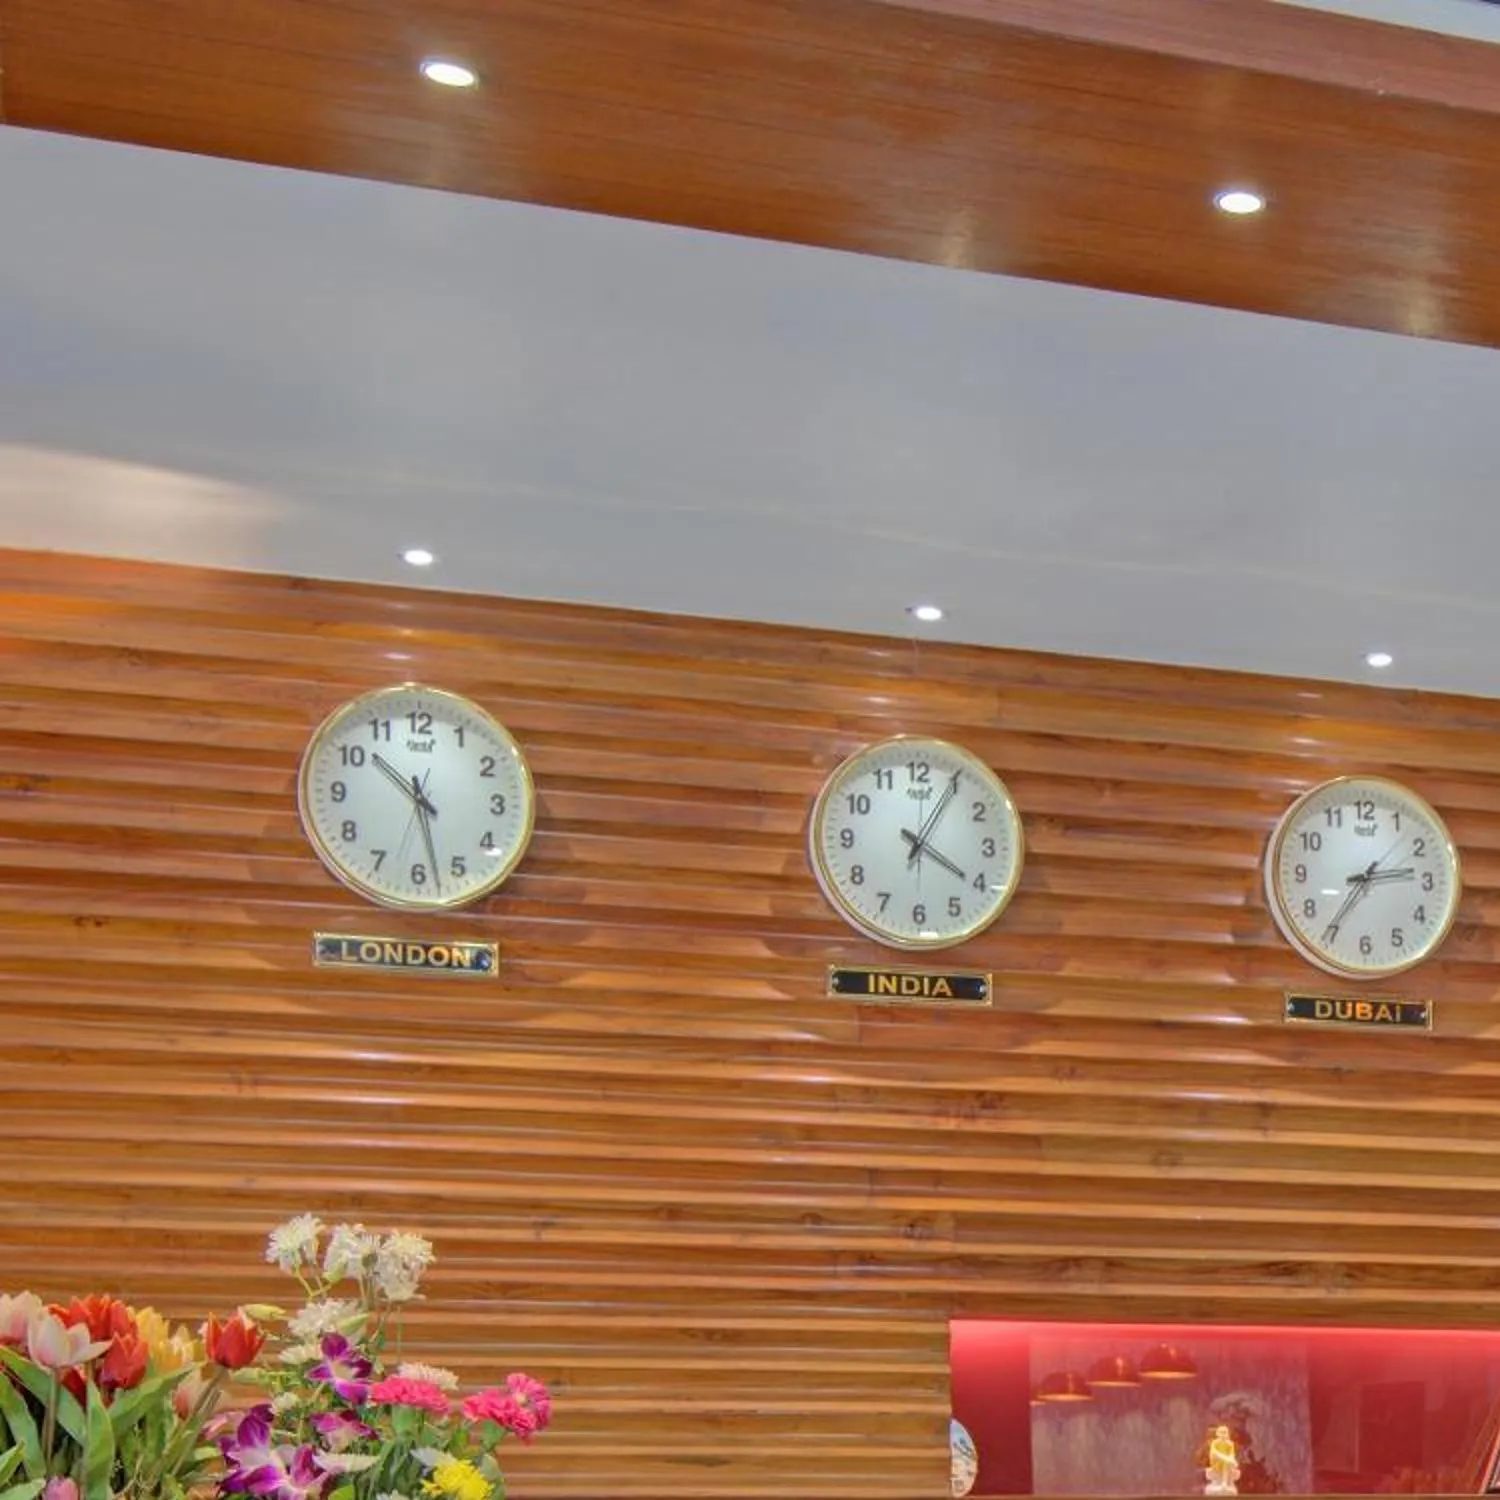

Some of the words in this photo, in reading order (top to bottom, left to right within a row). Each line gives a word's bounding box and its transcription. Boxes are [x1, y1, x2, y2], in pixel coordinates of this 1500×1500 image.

[369, 719, 391, 742] 11
[406, 712, 433, 734] 12
[453, 727, 465, 748] 1
[340, 746, 366, 767] 10
[479, 756, 495, 777] 2
[874, 769, 894, 790] 11
[906, 761, 930, 783] 12
[330, 782, 346, 802] 9
[490, 794, 506, 815] 3
[847, 794, 870, 815] 10
[972, 802, 986, 822] 2
[1354, 800, 1375, 821] 12
[1325, 808, 1343, 828] 11
[1392, 813, 1401, 832] 1
[342, 821, 357, 842] 8
[480, 831, 494, 849] 4
[840, 829, 854, 848] 9
[1300, 832, 1322, 851] 10
[982, 838, 996, 858] 3
[1413, 838, 1426, 857] 2
[370, 850, 386, 871] 7
[451, 857, 465, 877] 5
[411, 864, 427, 884] 6
[850, 865, 864, 885] 8
[973, 873, 985, 893] 4
[1295, 864, 1307, 882] 9
[1422, 873, 1434, 891] 3
[877, 893, 891, 912] 7
[948, 898, 961, 917] 5
[1304, 900, 1316, 918] 8
[913, 904, 926, 925] 6
[1413, 905, 1426, 924] 4
[1327, 926, 1339, 944] 7
[1359, 936, 1371, 954] 6
[1391, 929, 1403, 947] 5
[341, 942, 471, 968] LONDON
[868, 973, 952, 997] INDIA
[1314, 1000, 1401, 1023] DUBAI
